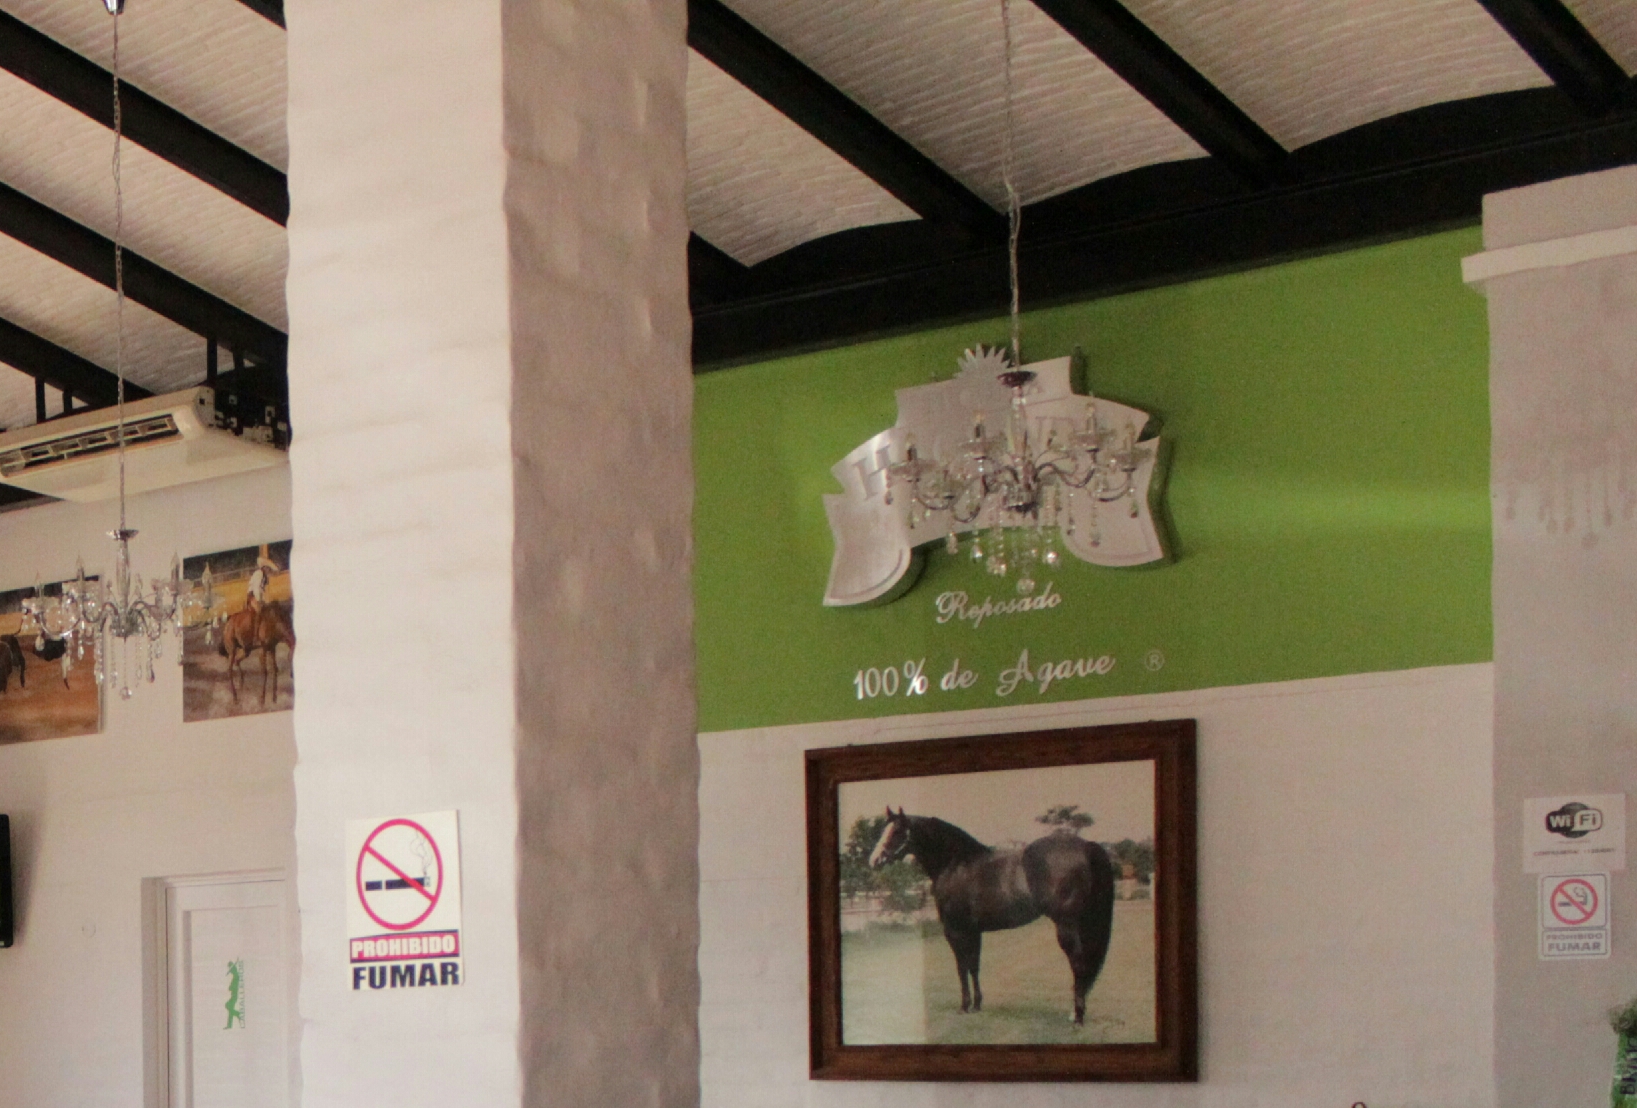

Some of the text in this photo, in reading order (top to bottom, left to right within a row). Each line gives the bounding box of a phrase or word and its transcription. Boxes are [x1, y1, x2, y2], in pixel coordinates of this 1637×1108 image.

[936, 582, 1062, 628] Reposado
[854, 658, 928, 699] 100%
[940, 658, 978, 690] de
[995, 649, 1116, 697] Agave
[351, 935, 456, 960] PROHIBIDO
[1548, 942, 1601, 952] FUMAR
[352, 961, 460, 990] FUMAR
